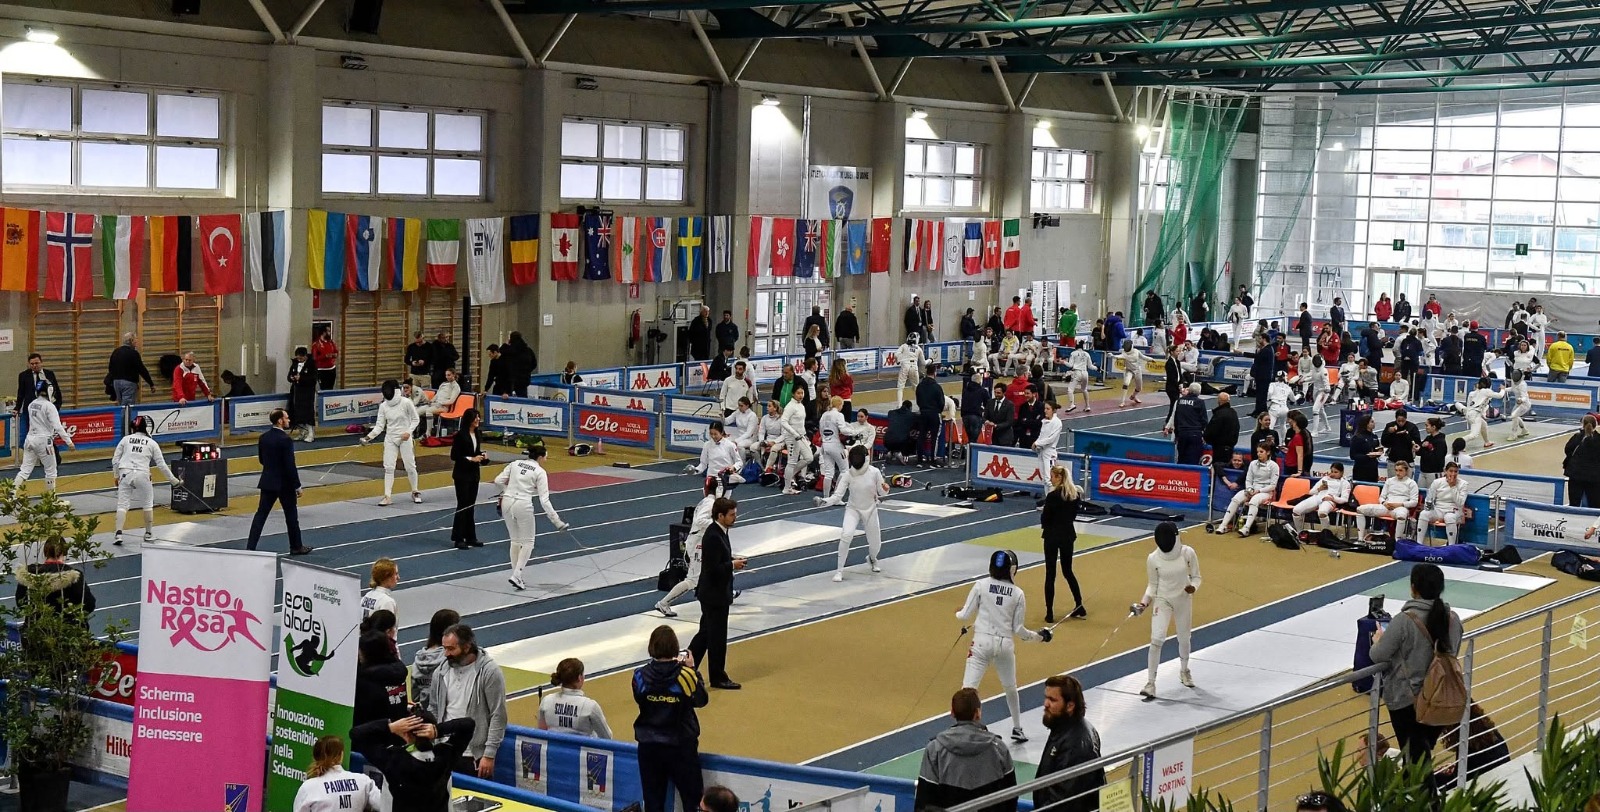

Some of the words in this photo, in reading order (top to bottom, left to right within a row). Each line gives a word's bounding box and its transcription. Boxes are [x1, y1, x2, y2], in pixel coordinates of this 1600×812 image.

[474, 232, 483, 256] FIE
[580, 414, 619, 433] Lete
[131, 445, 143, 453] HKG
[1100, 469, 1156, 492] Lete
[1166, 479, 1189, 487] ACQUA
[1178, 486, 1199, 494] SPORT
[1533, 529, 1565, 539] INAIL
[147, 579, 231, 609] Nastro
[284, 591, 313, 613] eco
[995, 595, 1004, 606] SUI
[161, 605, 225, 634] Rosa
[283, 608, 321, 636] blade
[95, 660, 137, 698] Le
[140, 685, 195, 703] Scherma
[646, 694, 680, 703] COLOMBIA
[138, 705, 202, 723] Inclusione
[276, 703, 325, 731] Innovazione
[558, 716, 573, 728] HUN
[137, 724, 203, 743] Benessere
[274, 743, 294, 760] nella
[522, 742, 533, 752] FIS
[587, 753, 599, 763] FIS
[272, 760, 308, 782] Scherma
[1162, 761, 1184, 777] WASTE
[323, 778, 359, 795] PAUKNER
[1158, 776, 1186, 795] SORTING
[339, 794, 352, 809] AUT
